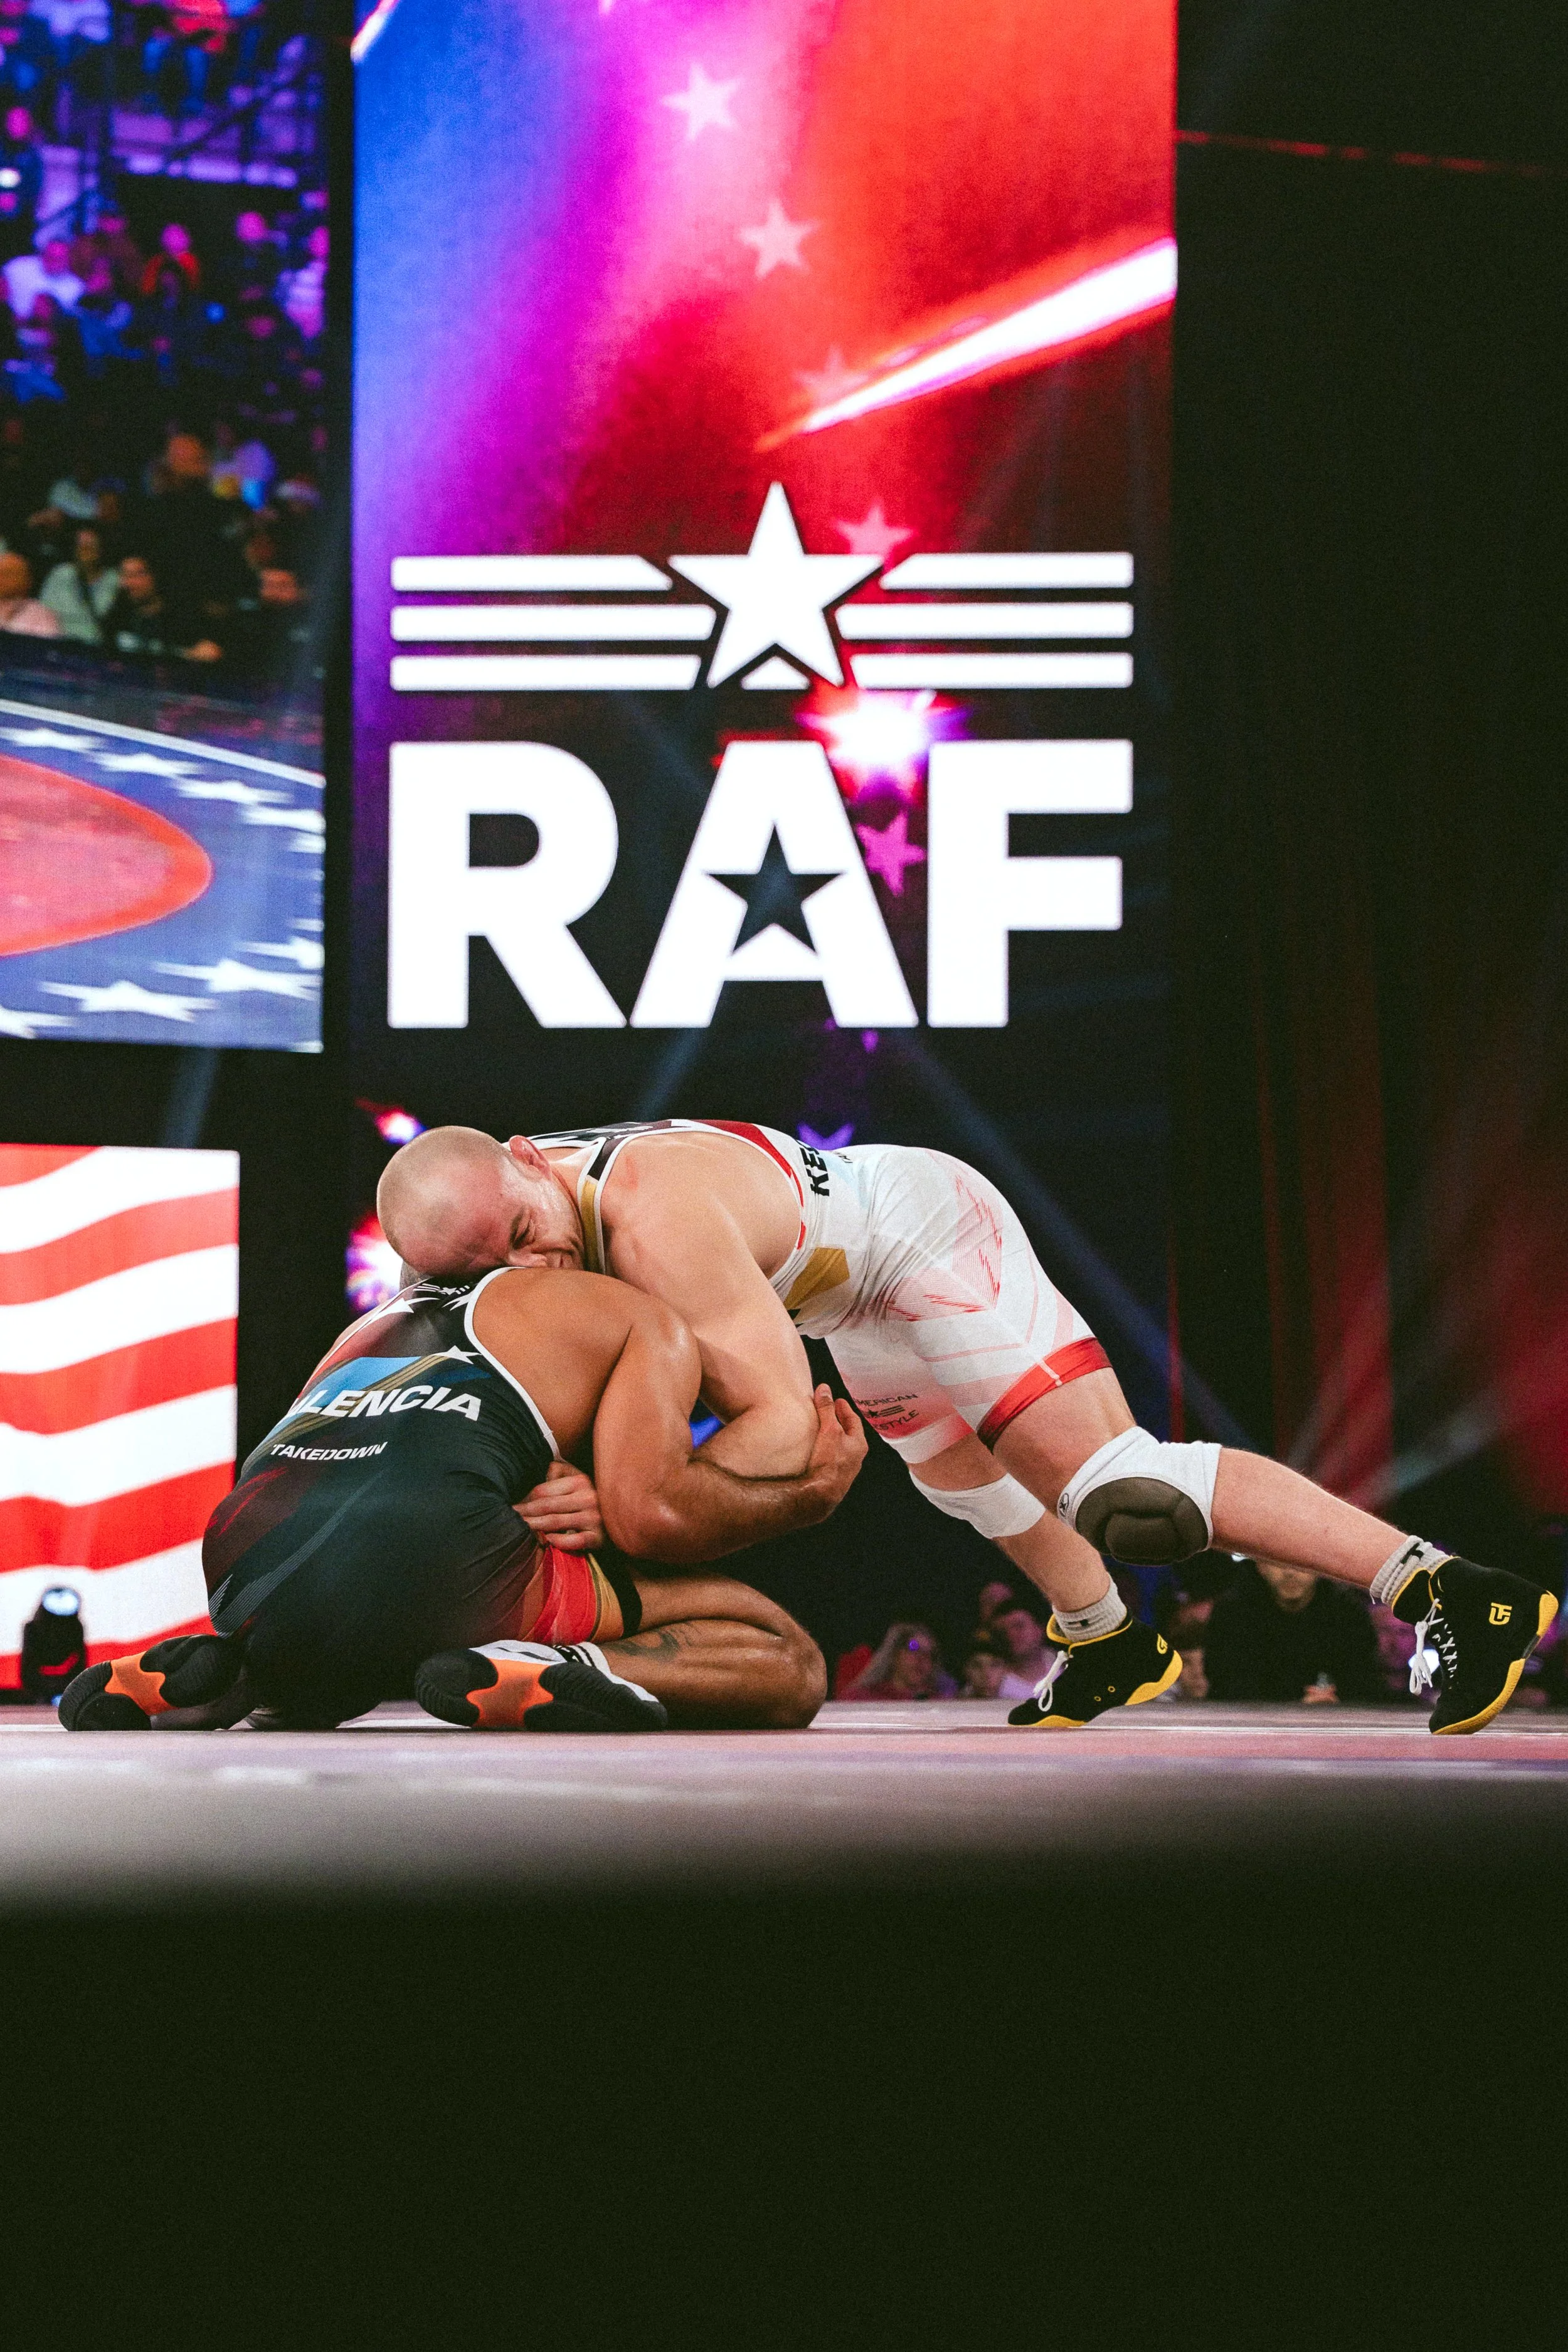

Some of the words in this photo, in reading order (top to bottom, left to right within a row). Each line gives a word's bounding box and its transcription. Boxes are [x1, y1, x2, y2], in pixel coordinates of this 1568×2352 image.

[388, 739, 1133, 1029] RAF
[795, 1140, 830, 1197] KE
[270, 1442, 388, 1461] TAKEDOWN
